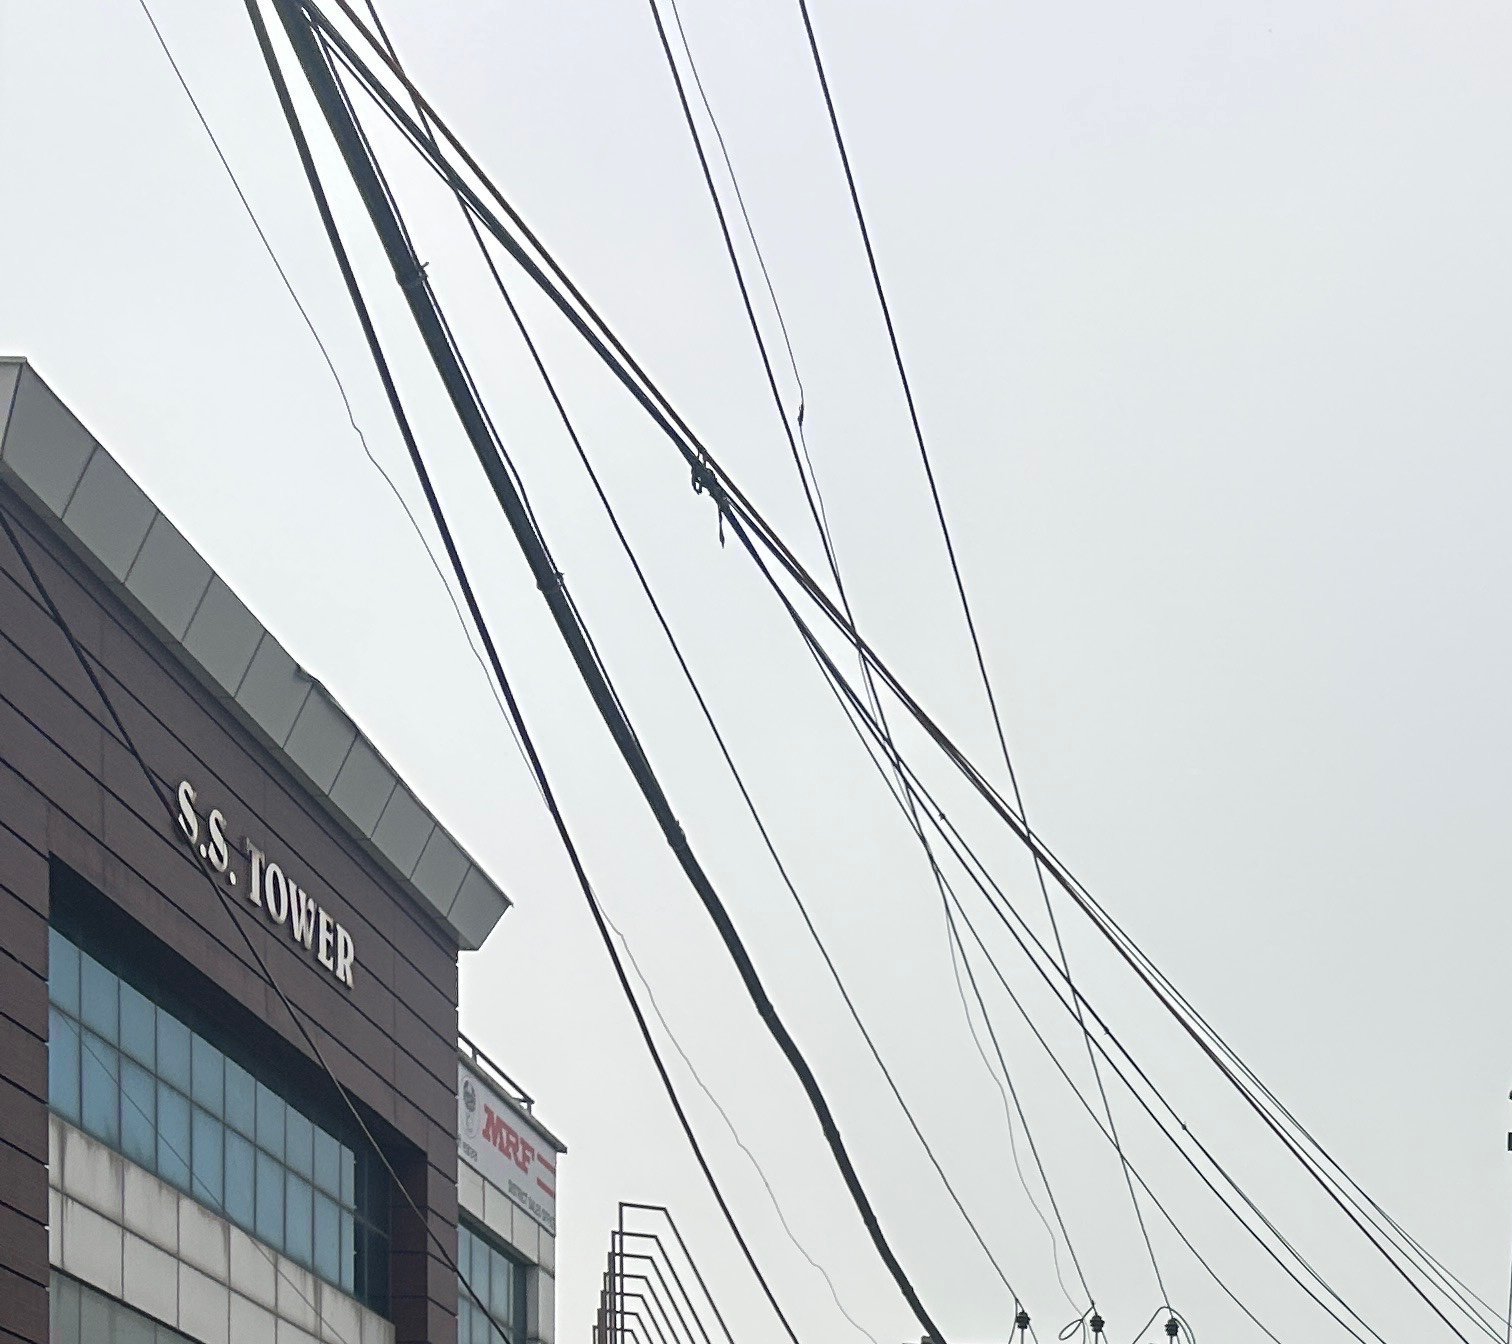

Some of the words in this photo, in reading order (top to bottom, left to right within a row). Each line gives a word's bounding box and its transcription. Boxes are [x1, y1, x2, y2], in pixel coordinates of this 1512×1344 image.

[178, 780, 237, 885] S.S.
[246, 837, 354, 990] TOWER
[481, 1104, 535, 1175] MRF
